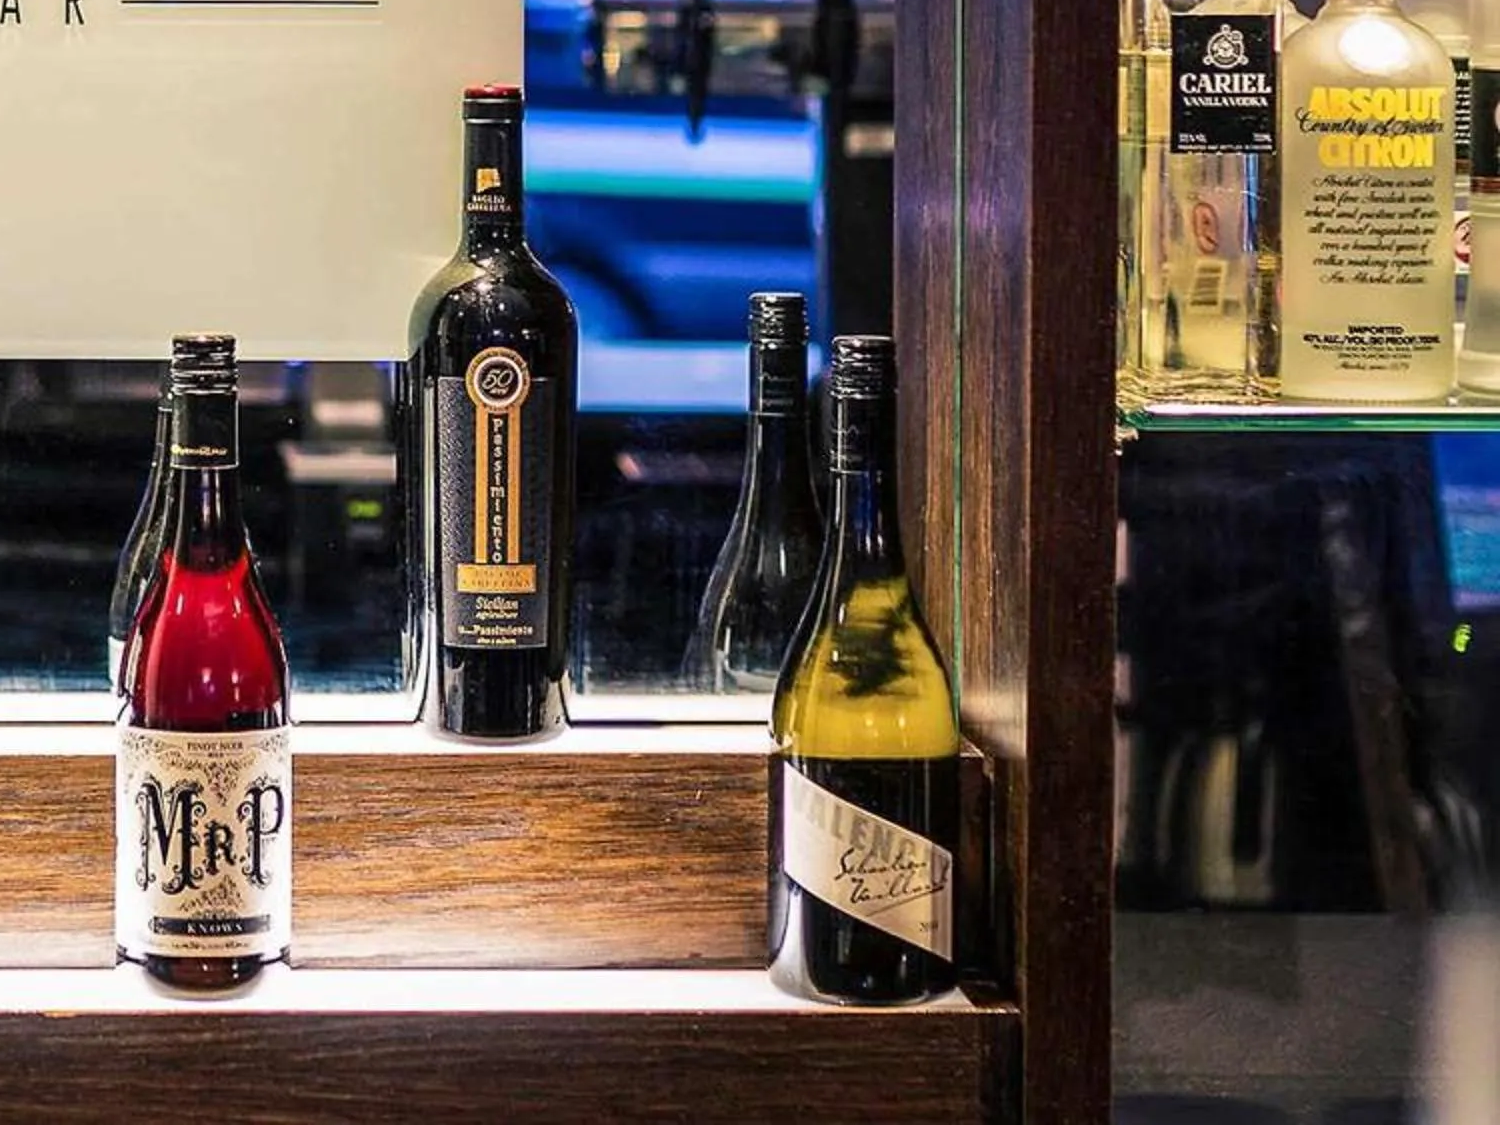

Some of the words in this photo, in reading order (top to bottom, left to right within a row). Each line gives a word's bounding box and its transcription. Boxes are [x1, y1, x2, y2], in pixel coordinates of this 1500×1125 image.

[1179, 72, 1272, 94] CARIEL
[1308, 86, 1447, 121] ABSOLUT
[1295, 107, 1369, 136] Country
[1318, 133, 1435, 169] CITRON
[185, 922, 245, 935] KNOWS
